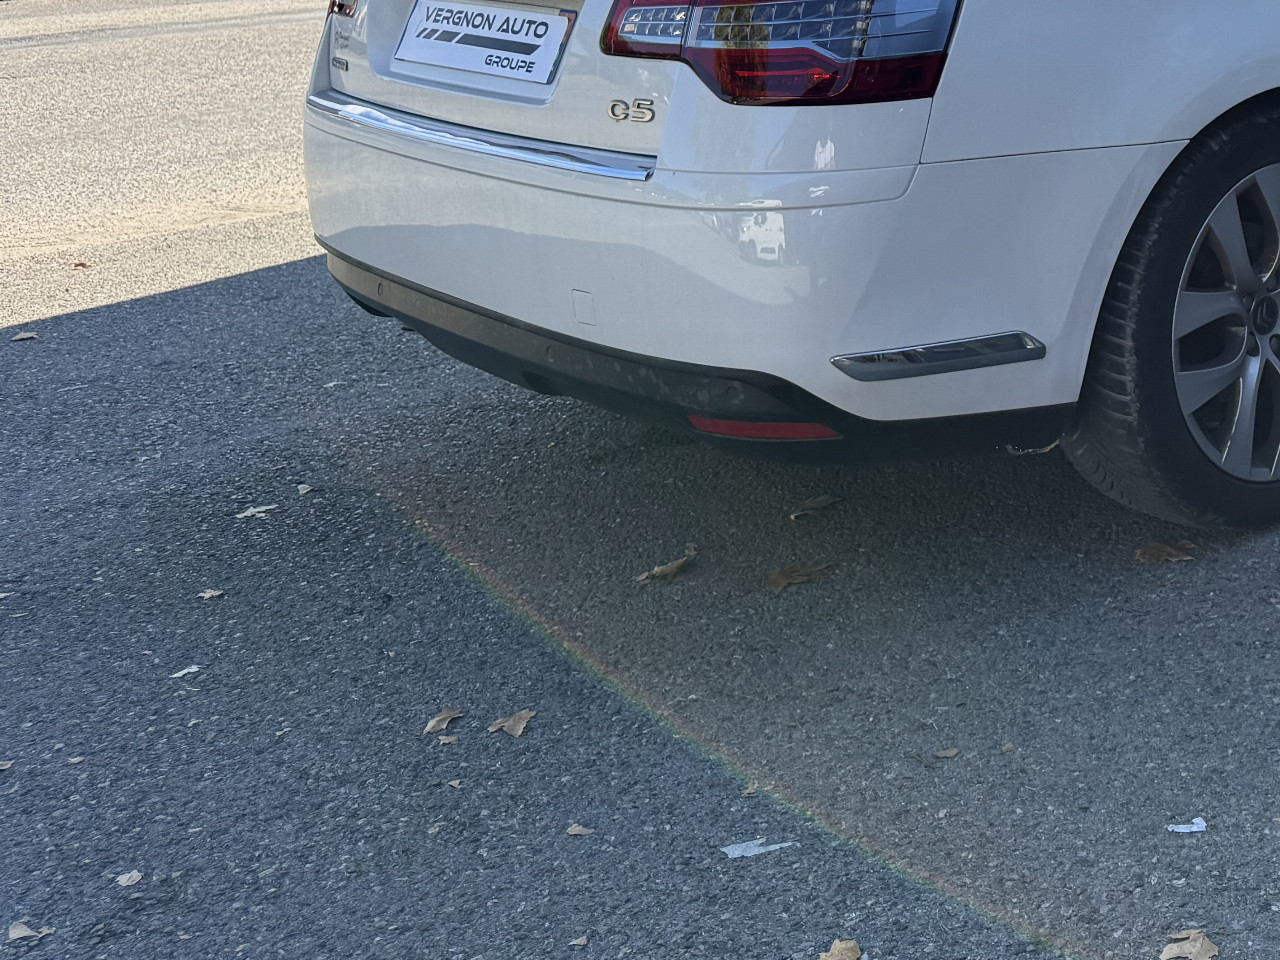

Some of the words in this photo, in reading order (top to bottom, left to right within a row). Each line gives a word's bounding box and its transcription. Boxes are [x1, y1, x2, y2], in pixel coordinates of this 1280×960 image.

[425, 6, 496, 31] VERGNON
[497, 16, 549, 39] AUTO
[484, 54, 536, 73] GROUPE
[607, 98, 656, 123] C5
